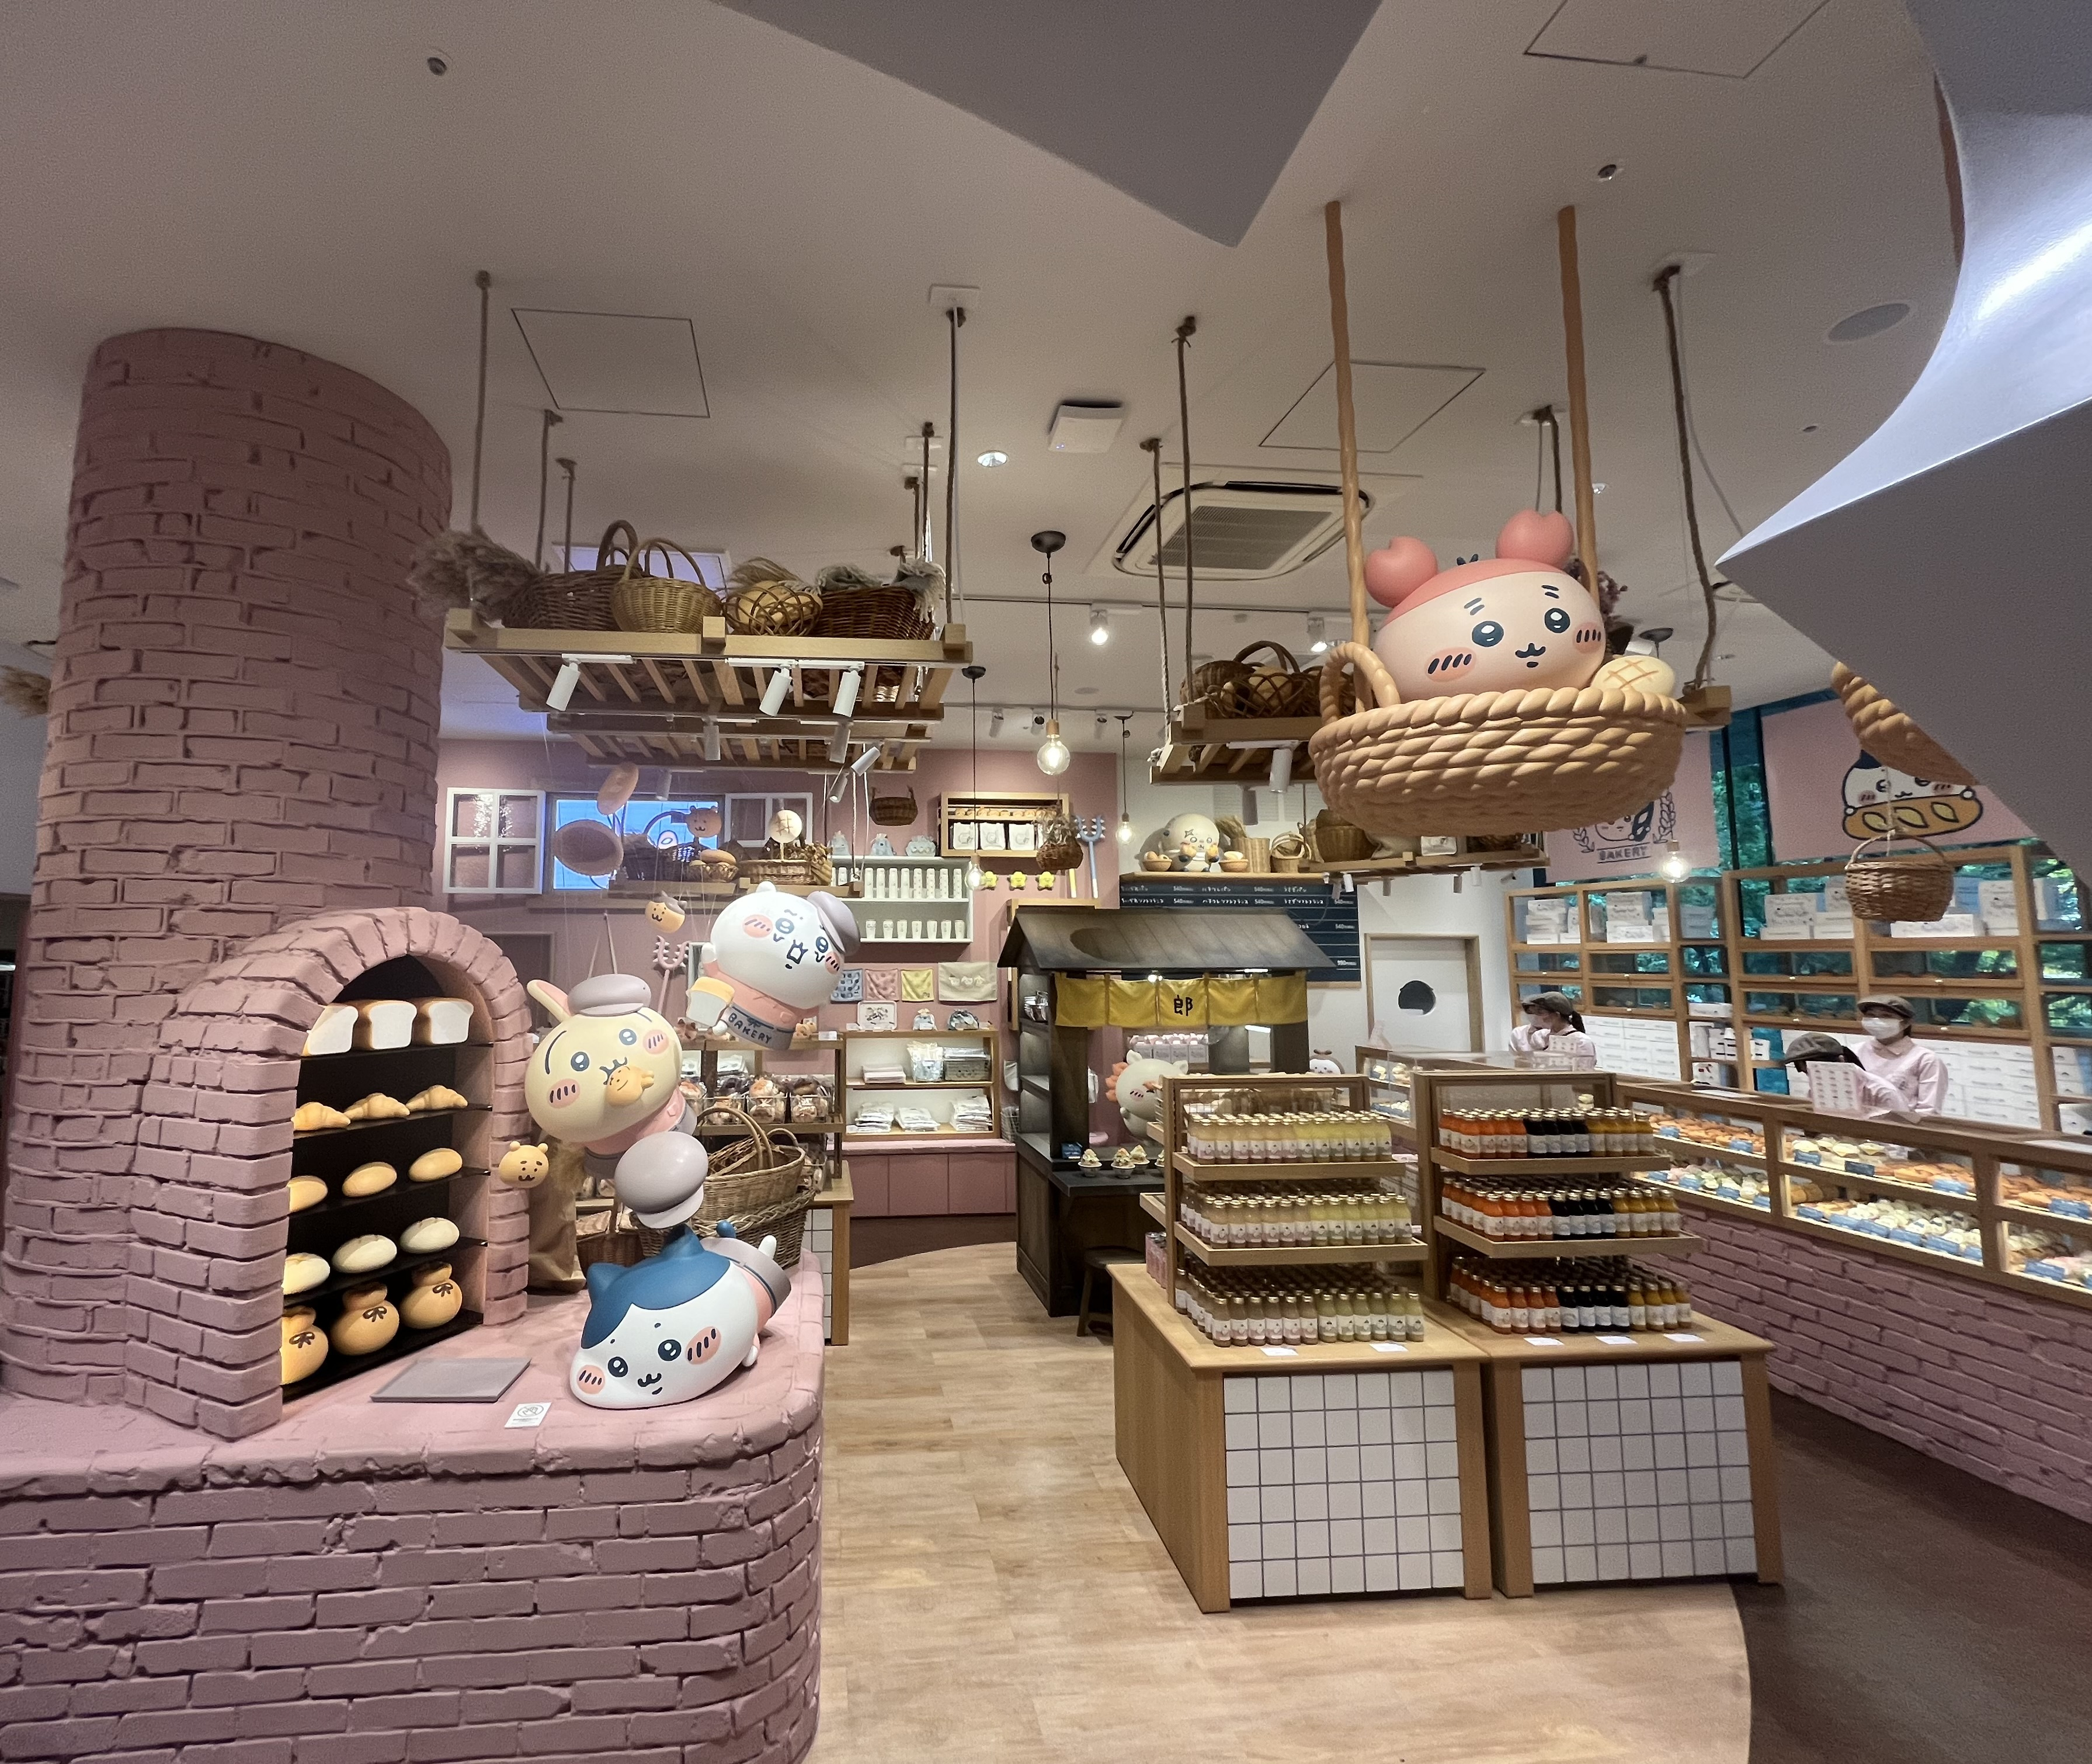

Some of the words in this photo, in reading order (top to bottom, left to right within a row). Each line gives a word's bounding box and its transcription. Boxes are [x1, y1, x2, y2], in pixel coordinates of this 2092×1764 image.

[1599, 846, 1646, 860] BAKERY
[1174, 994, 1193, 1016] 郎
[728, 1012, 772, 1044] BAKERY
